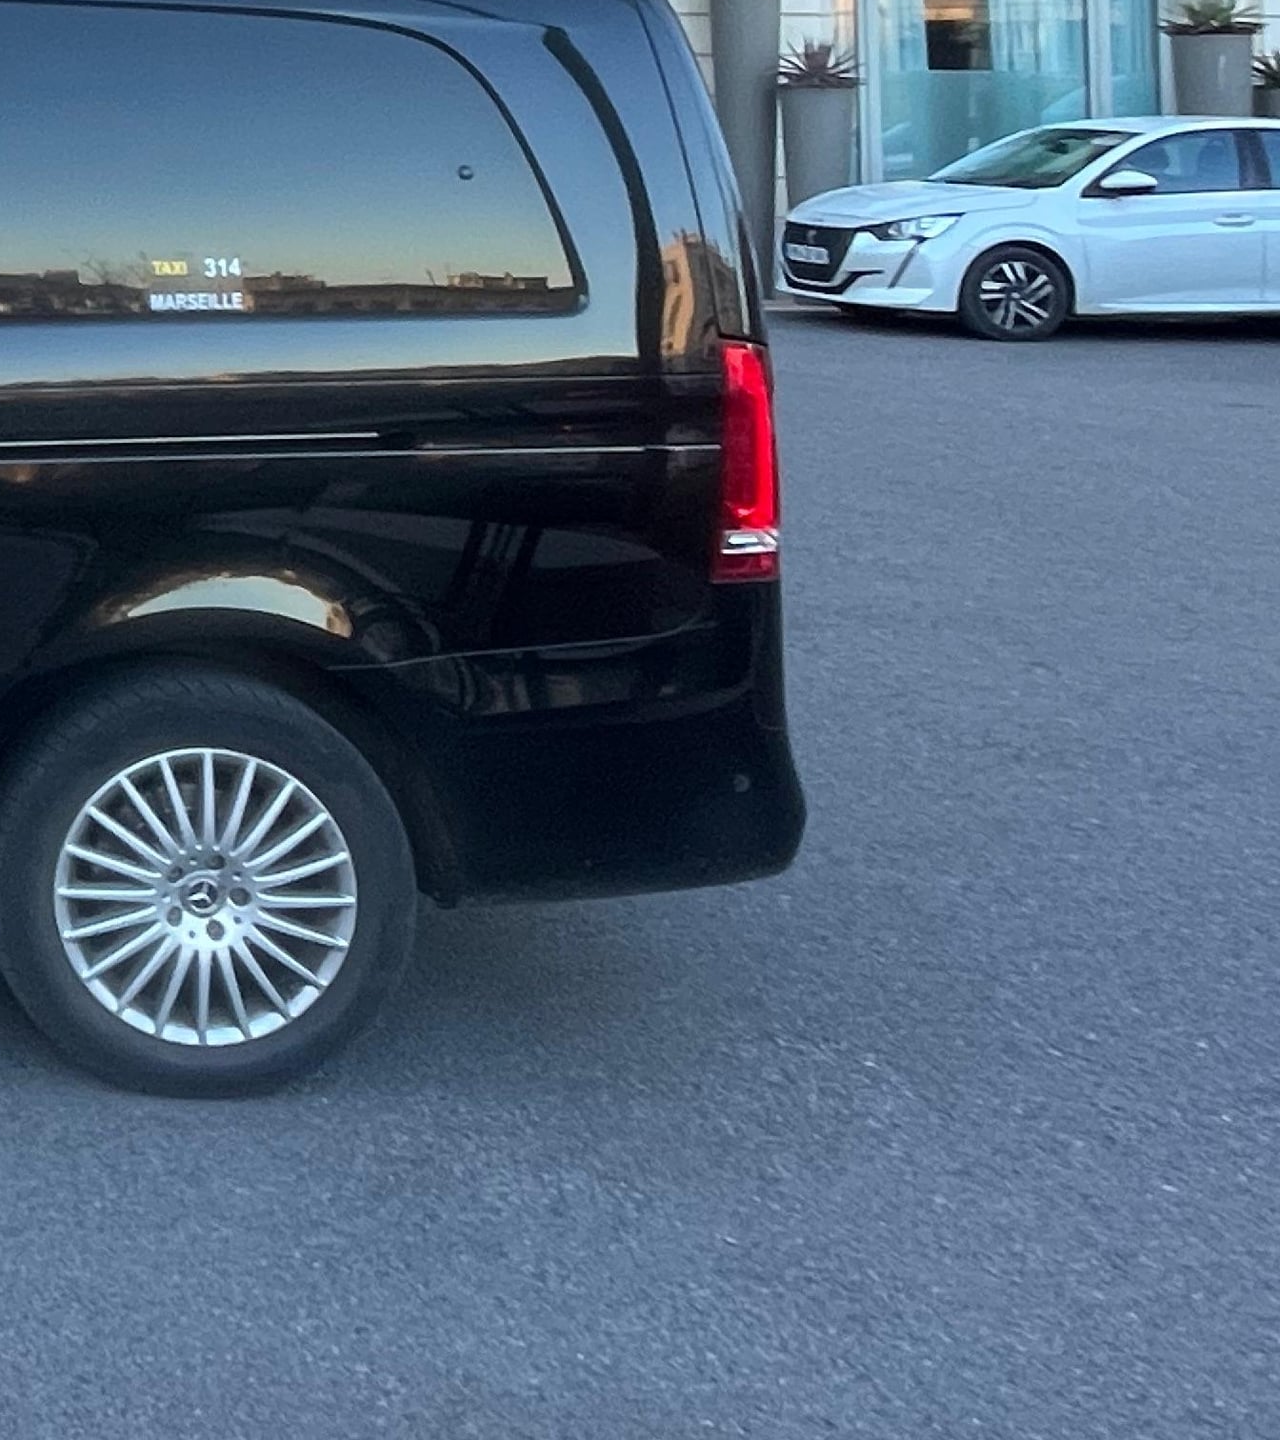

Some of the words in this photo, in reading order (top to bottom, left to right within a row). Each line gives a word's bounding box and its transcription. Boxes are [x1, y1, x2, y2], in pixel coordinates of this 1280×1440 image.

[151, 260, 188, 276] TAXI
[203, 258, 242, 278] 314
[149, 292, 243, 310] MARSEILLE
